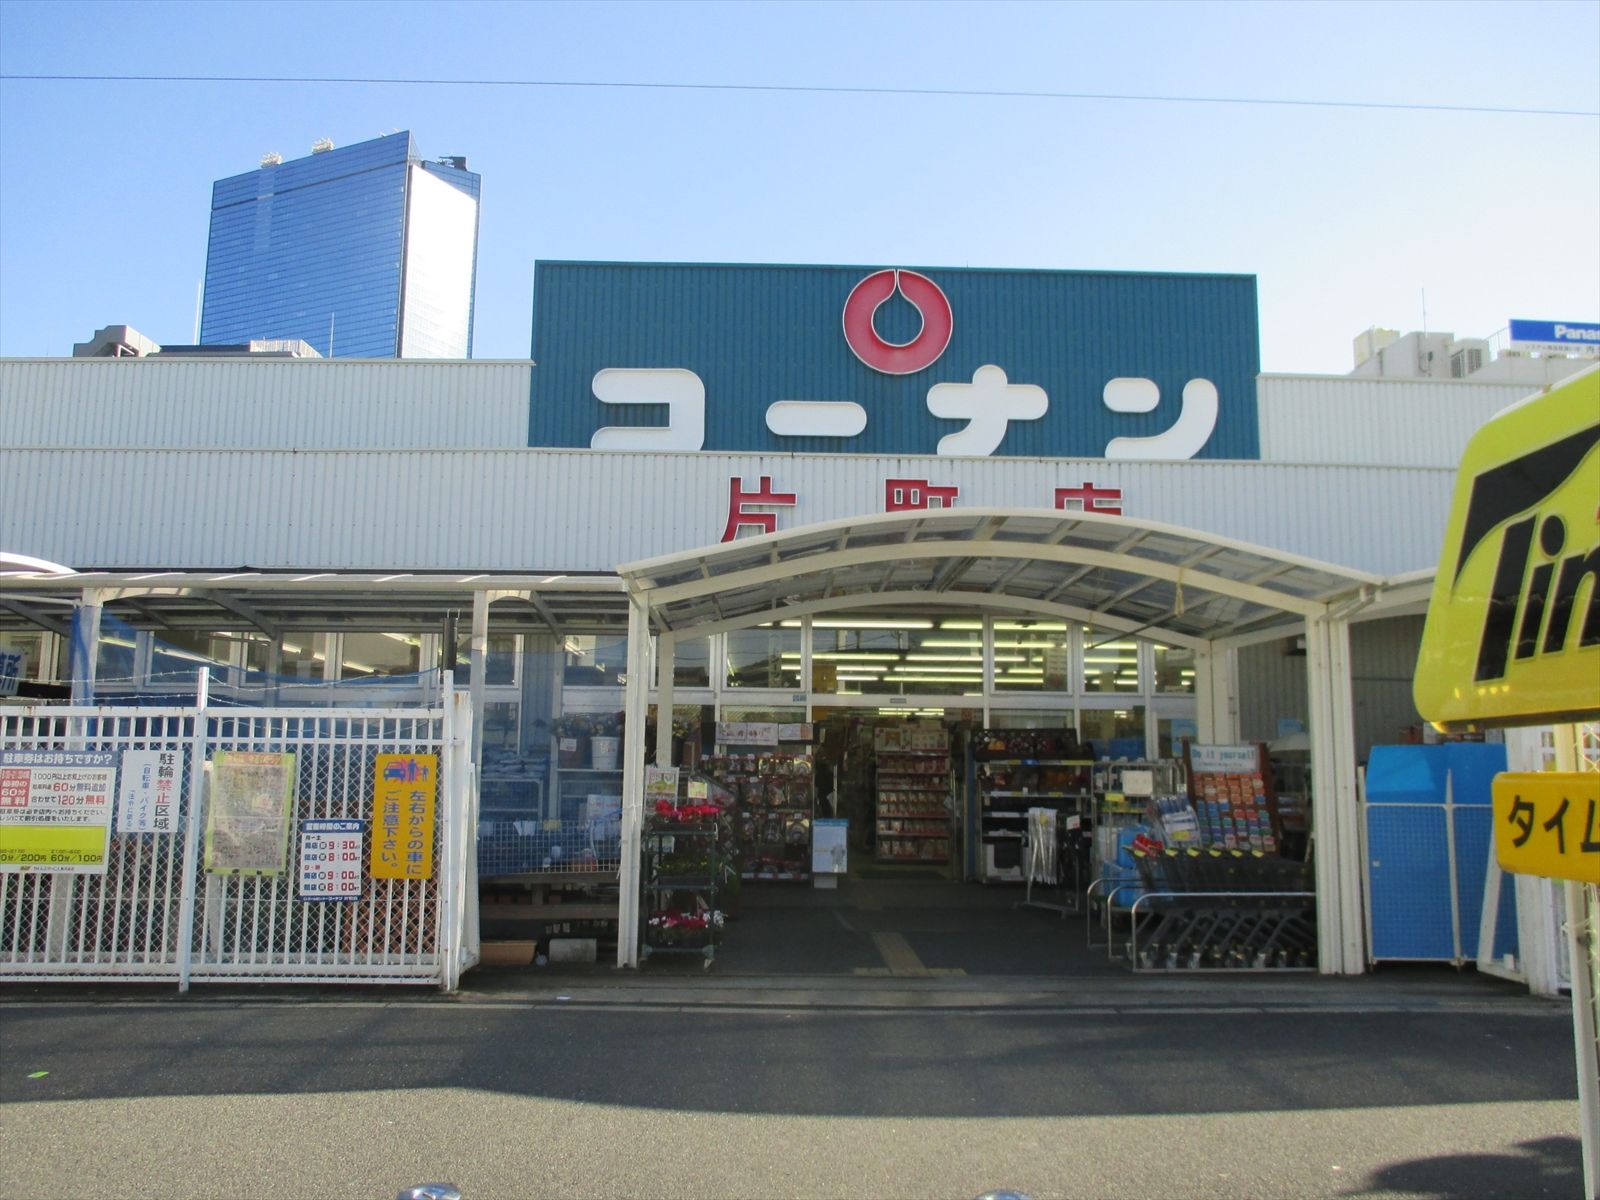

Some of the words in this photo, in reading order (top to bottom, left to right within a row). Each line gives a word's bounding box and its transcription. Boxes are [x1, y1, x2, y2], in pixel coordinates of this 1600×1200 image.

[590, 364, 1219, 459] コーナン
[153, 753, 175, 830] 駐輪禁止区域
[328, 841, 355, 850] 9:30
[382, 790, 401, 867] ご注意下さい。
[406, 790, 426, 874] 左右からの車に
[327, 871, 355, 880] 9:00
[328, 853, 355, 861] 8:00
[327, 883, 355, 891] 8:00
